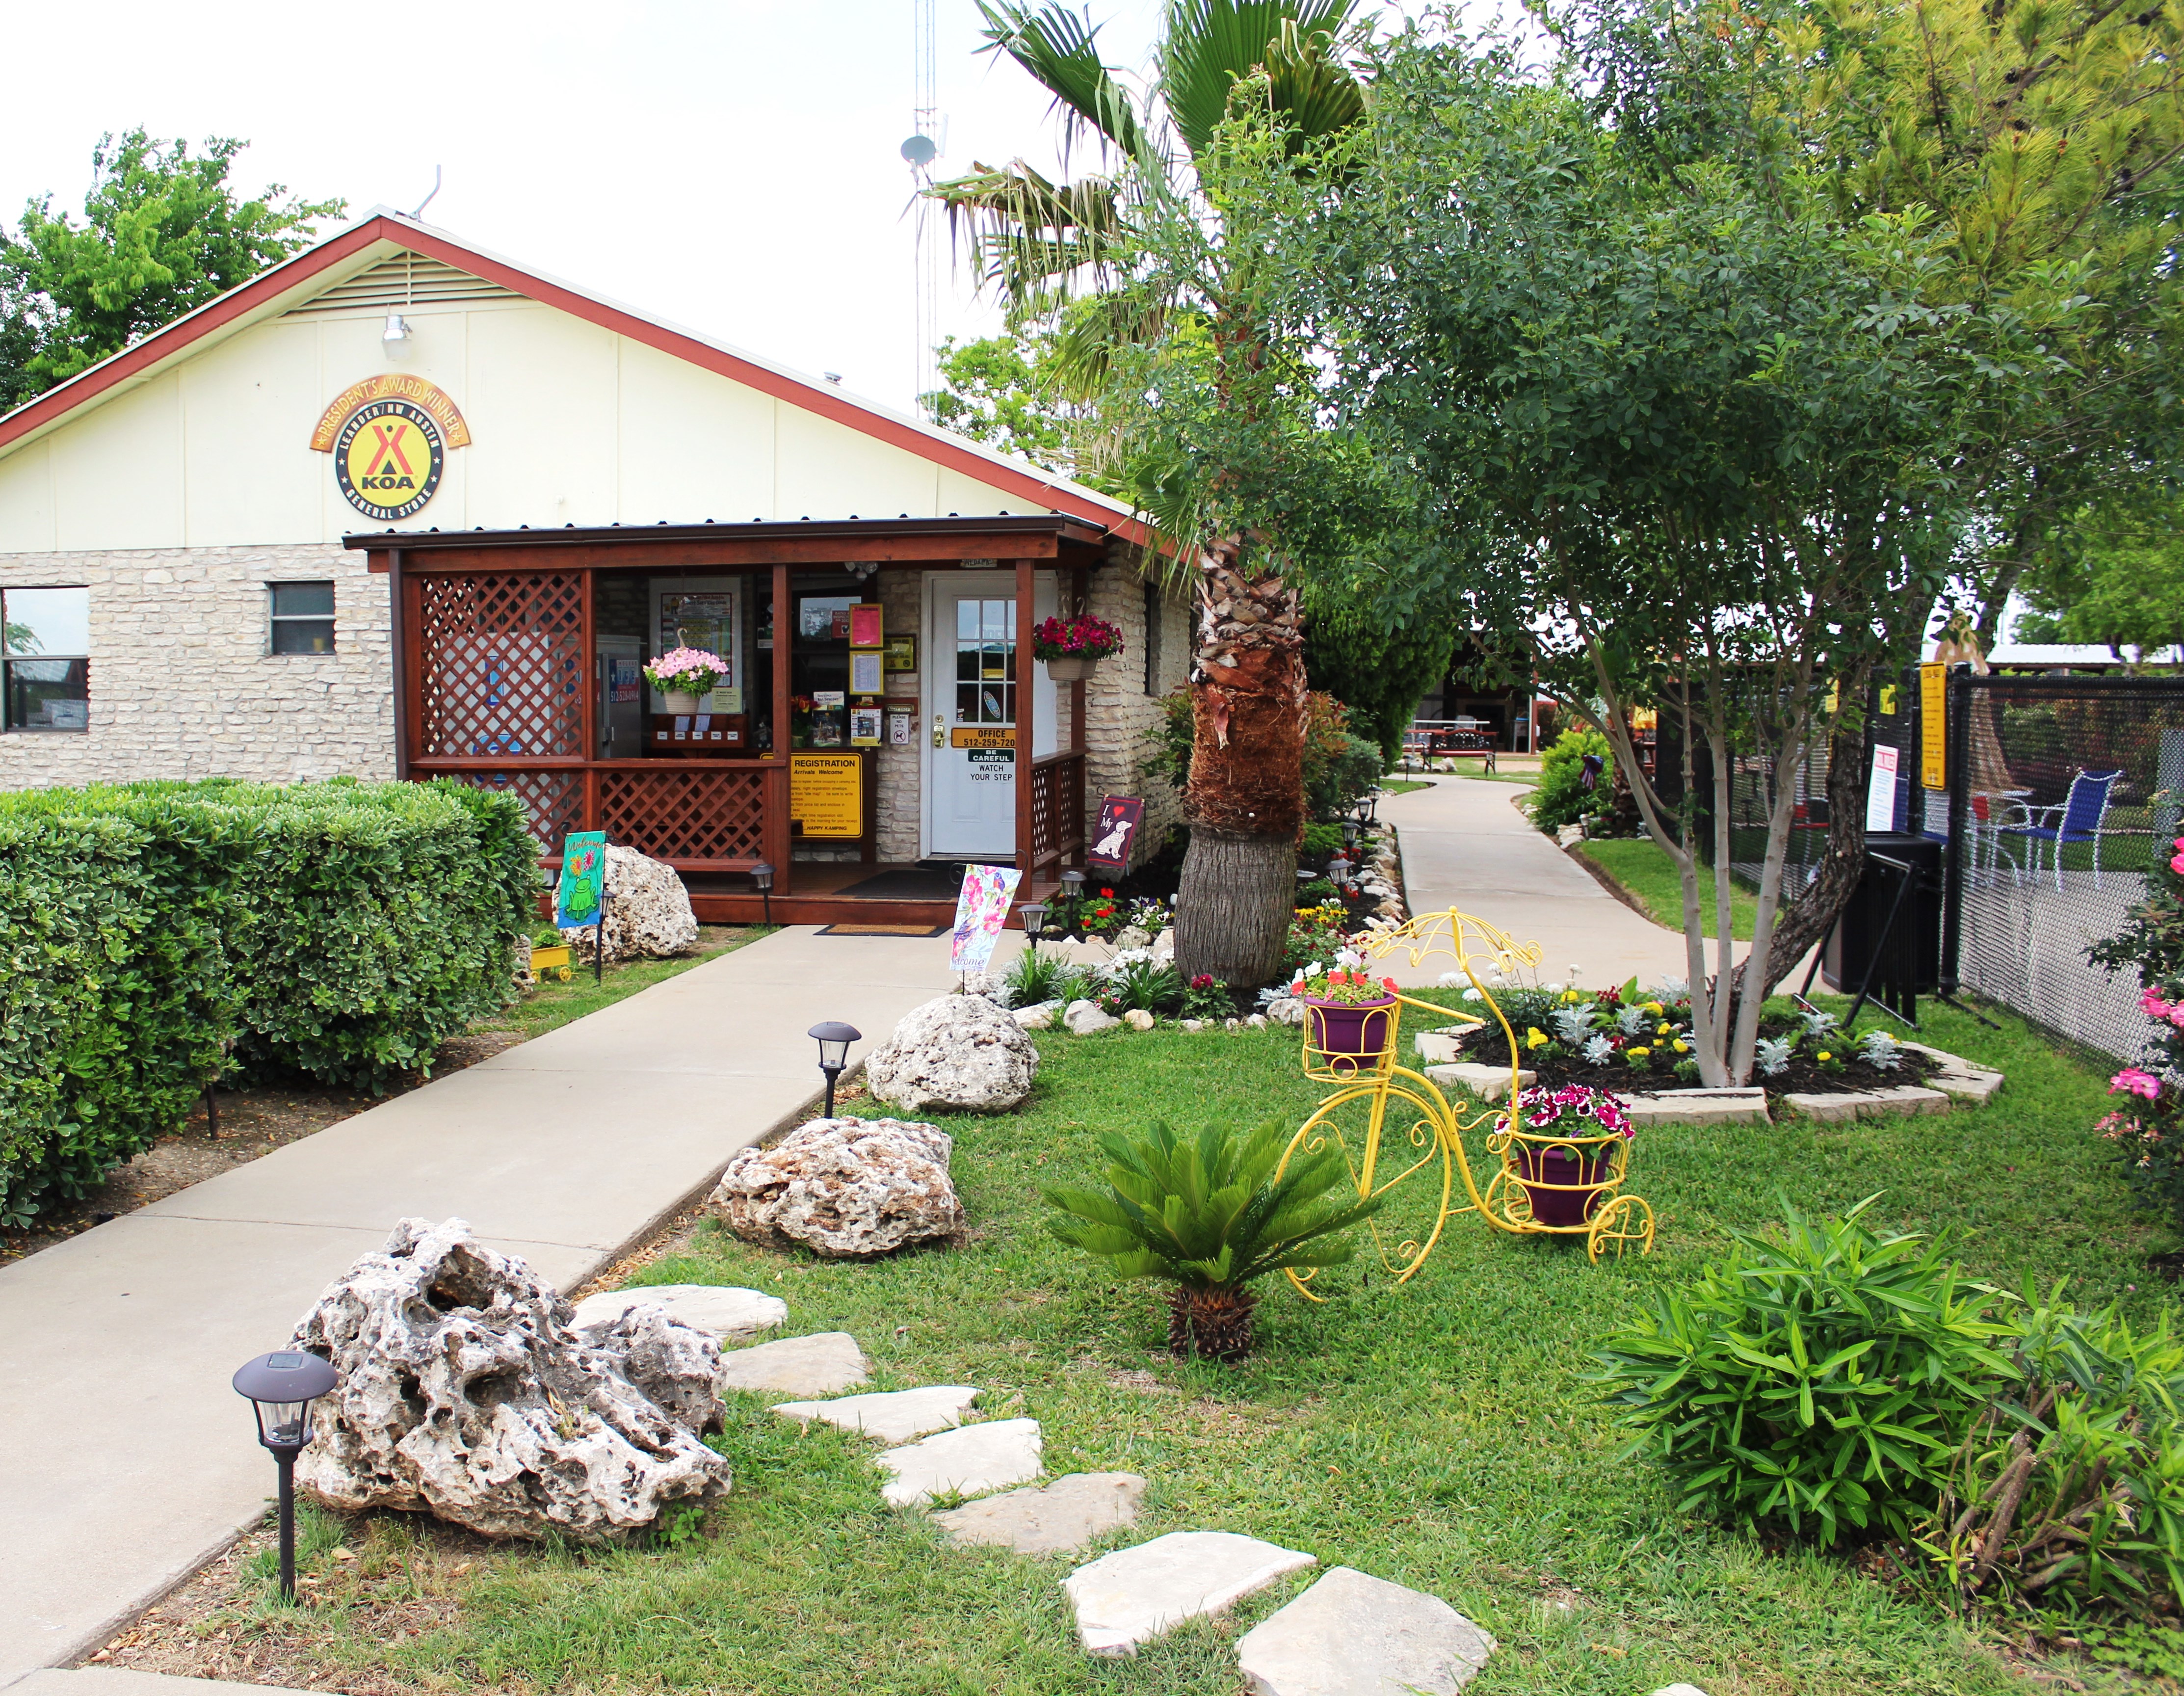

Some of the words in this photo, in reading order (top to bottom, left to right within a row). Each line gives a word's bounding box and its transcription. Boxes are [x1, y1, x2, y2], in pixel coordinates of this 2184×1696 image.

[317, 377, 379, 437] PRESIDENT'S
[381, 377, 422, 398] AWARD
[423, 388, 463, 435] WINNER
[409, 409, 440, 449] AUSTIN
[362, 476, 415, 489] KOA
[345, 489, 393, 519] GENERAL
[399, 488, 432, 517] STORE
[1102, 804, 1110, 816] I
[1100, 817, 1113, 831] My
[568, 836, 602, 852] Welcome
